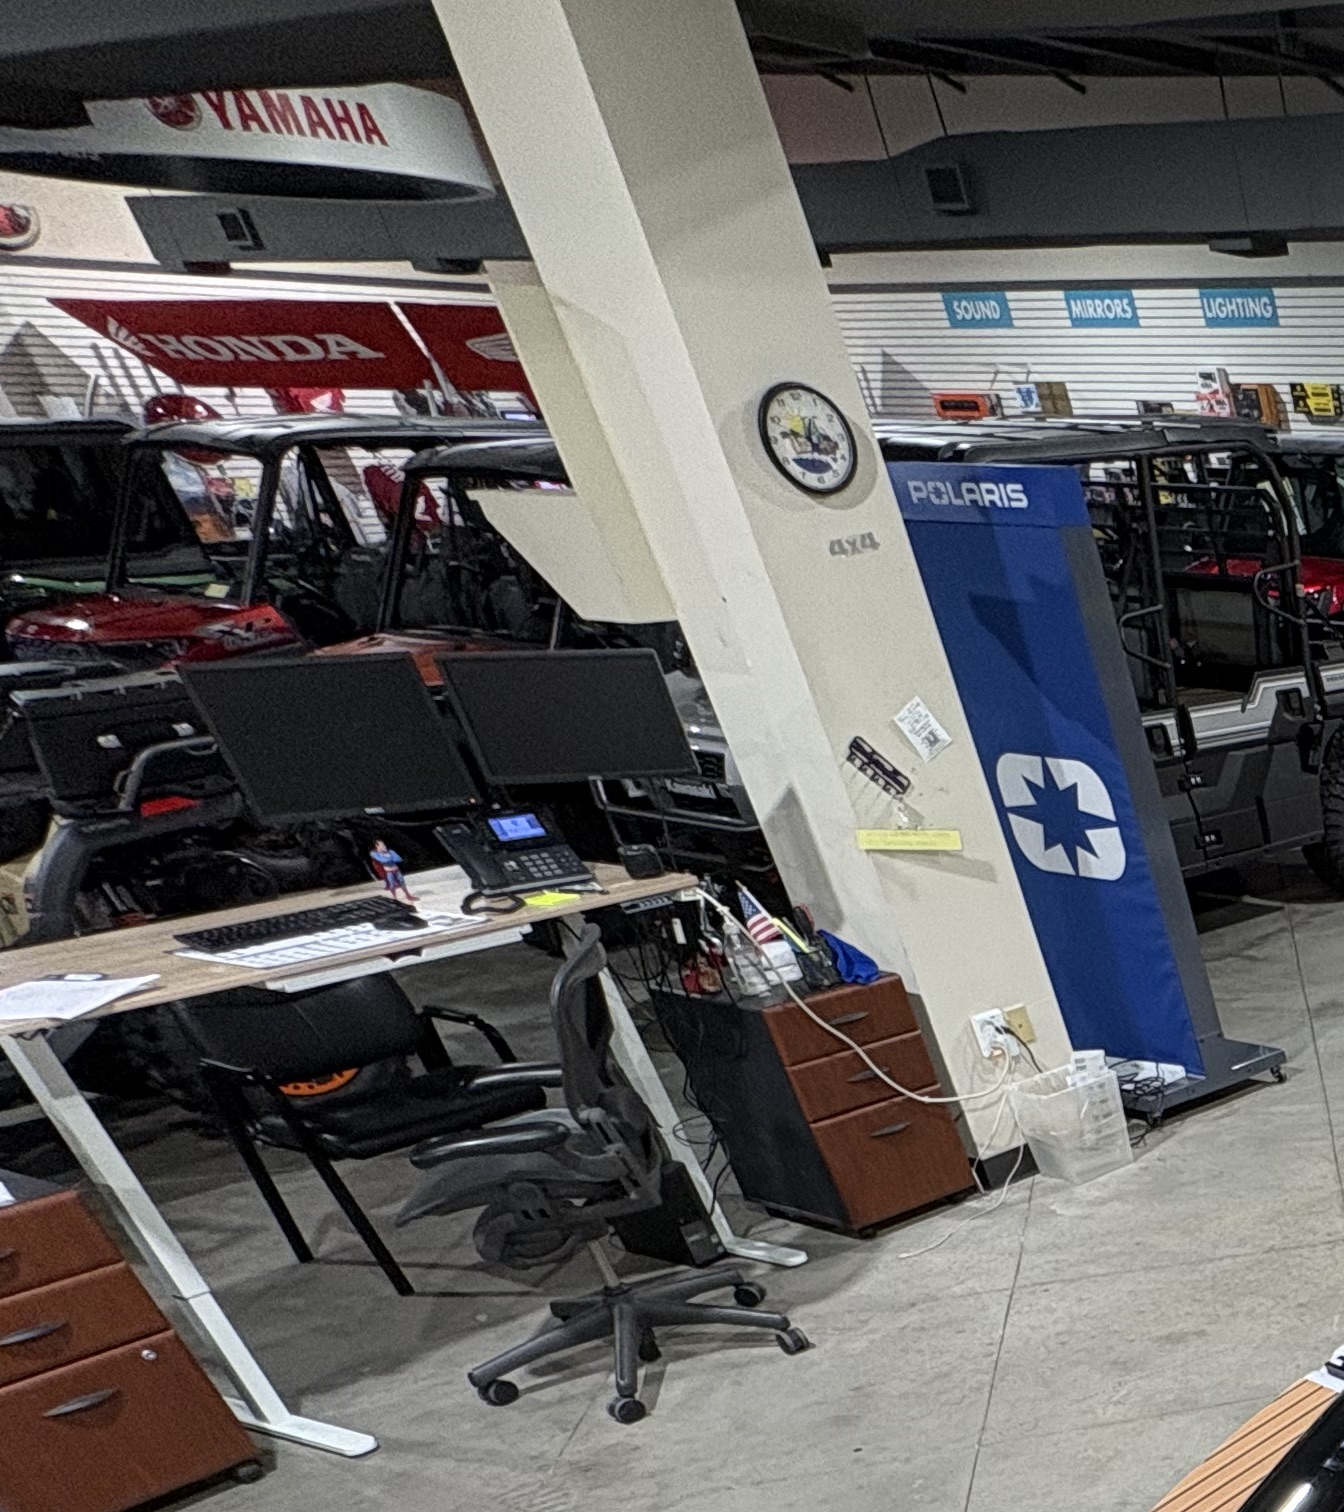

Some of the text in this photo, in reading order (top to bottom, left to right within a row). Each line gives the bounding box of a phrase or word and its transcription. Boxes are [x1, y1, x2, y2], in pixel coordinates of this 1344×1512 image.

[199, 89, 389, 147] YAMAHA
[952, 299, 1000, 320] SOUND
[1070, 298, 1133, 320] MIRRORS
[1203, 296, 1274, 319] LIGHTING
[139, 332, 386, 362] HONDA
[906, 479, 1029, 510] POLARIS
